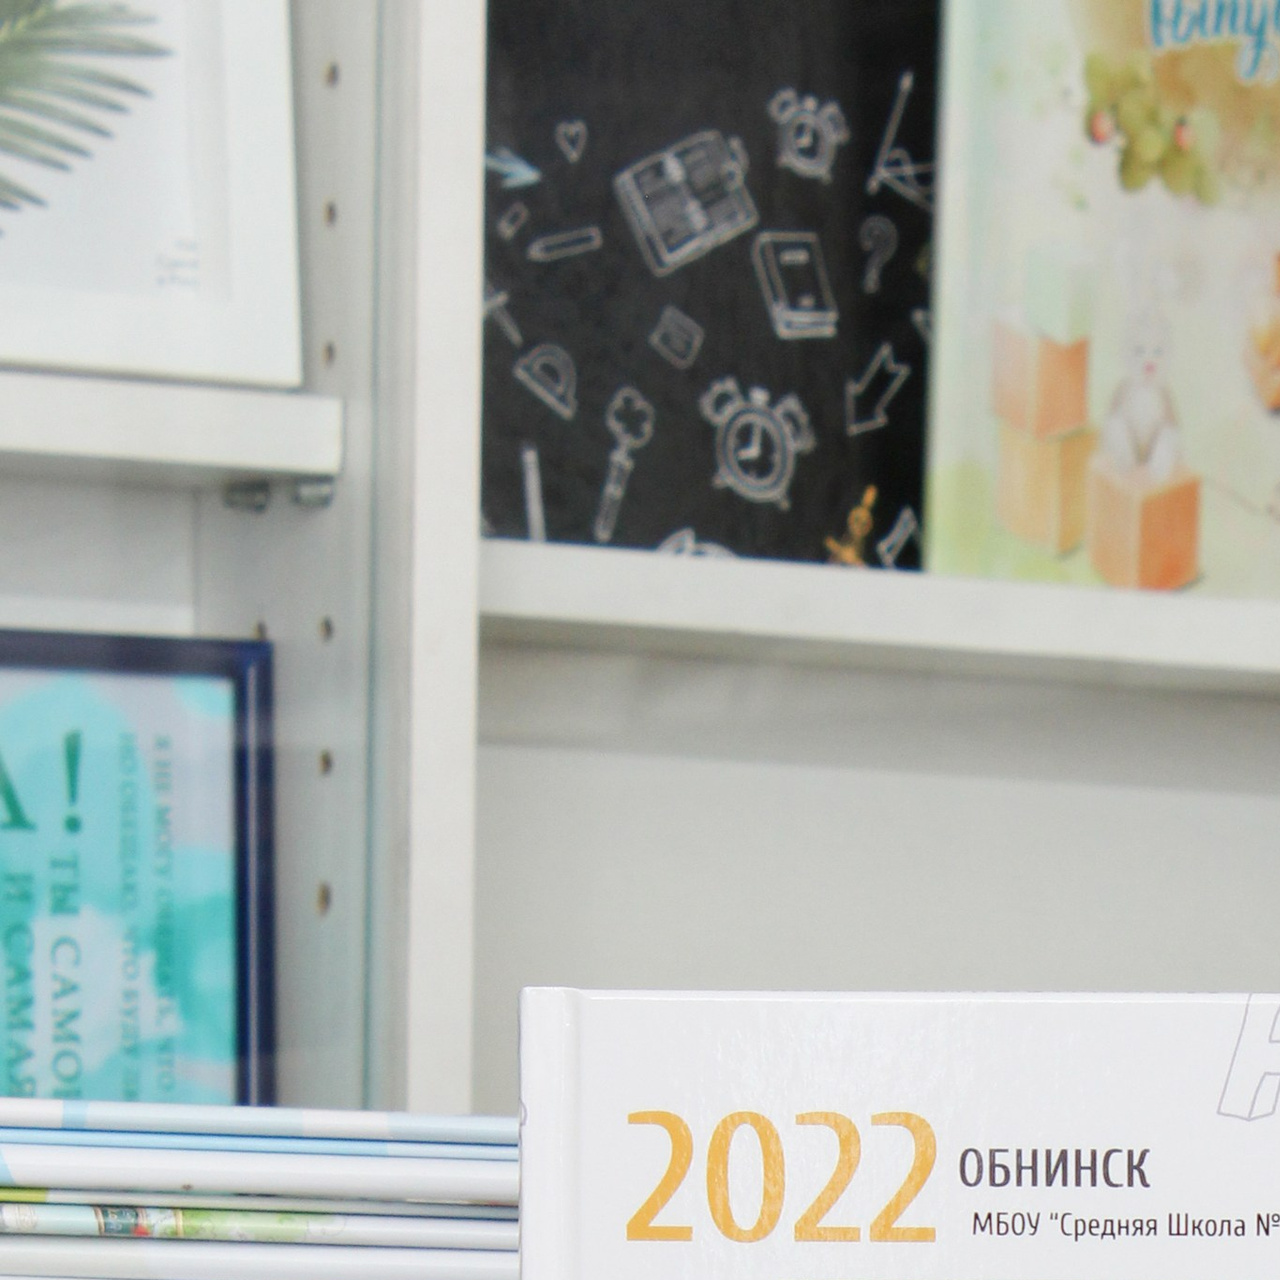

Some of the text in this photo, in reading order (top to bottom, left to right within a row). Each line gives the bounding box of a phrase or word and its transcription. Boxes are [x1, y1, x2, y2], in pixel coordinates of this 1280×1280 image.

[626, 1111, 938, 1243] 2022
[959, 1148, 1151, 1189] ОБНИНСК
[972, 1212, 1041, 1236] МБОУ
[1168, 1213, 1246, 1237] Школа
[1256, 1213, 1280, 1236] №
